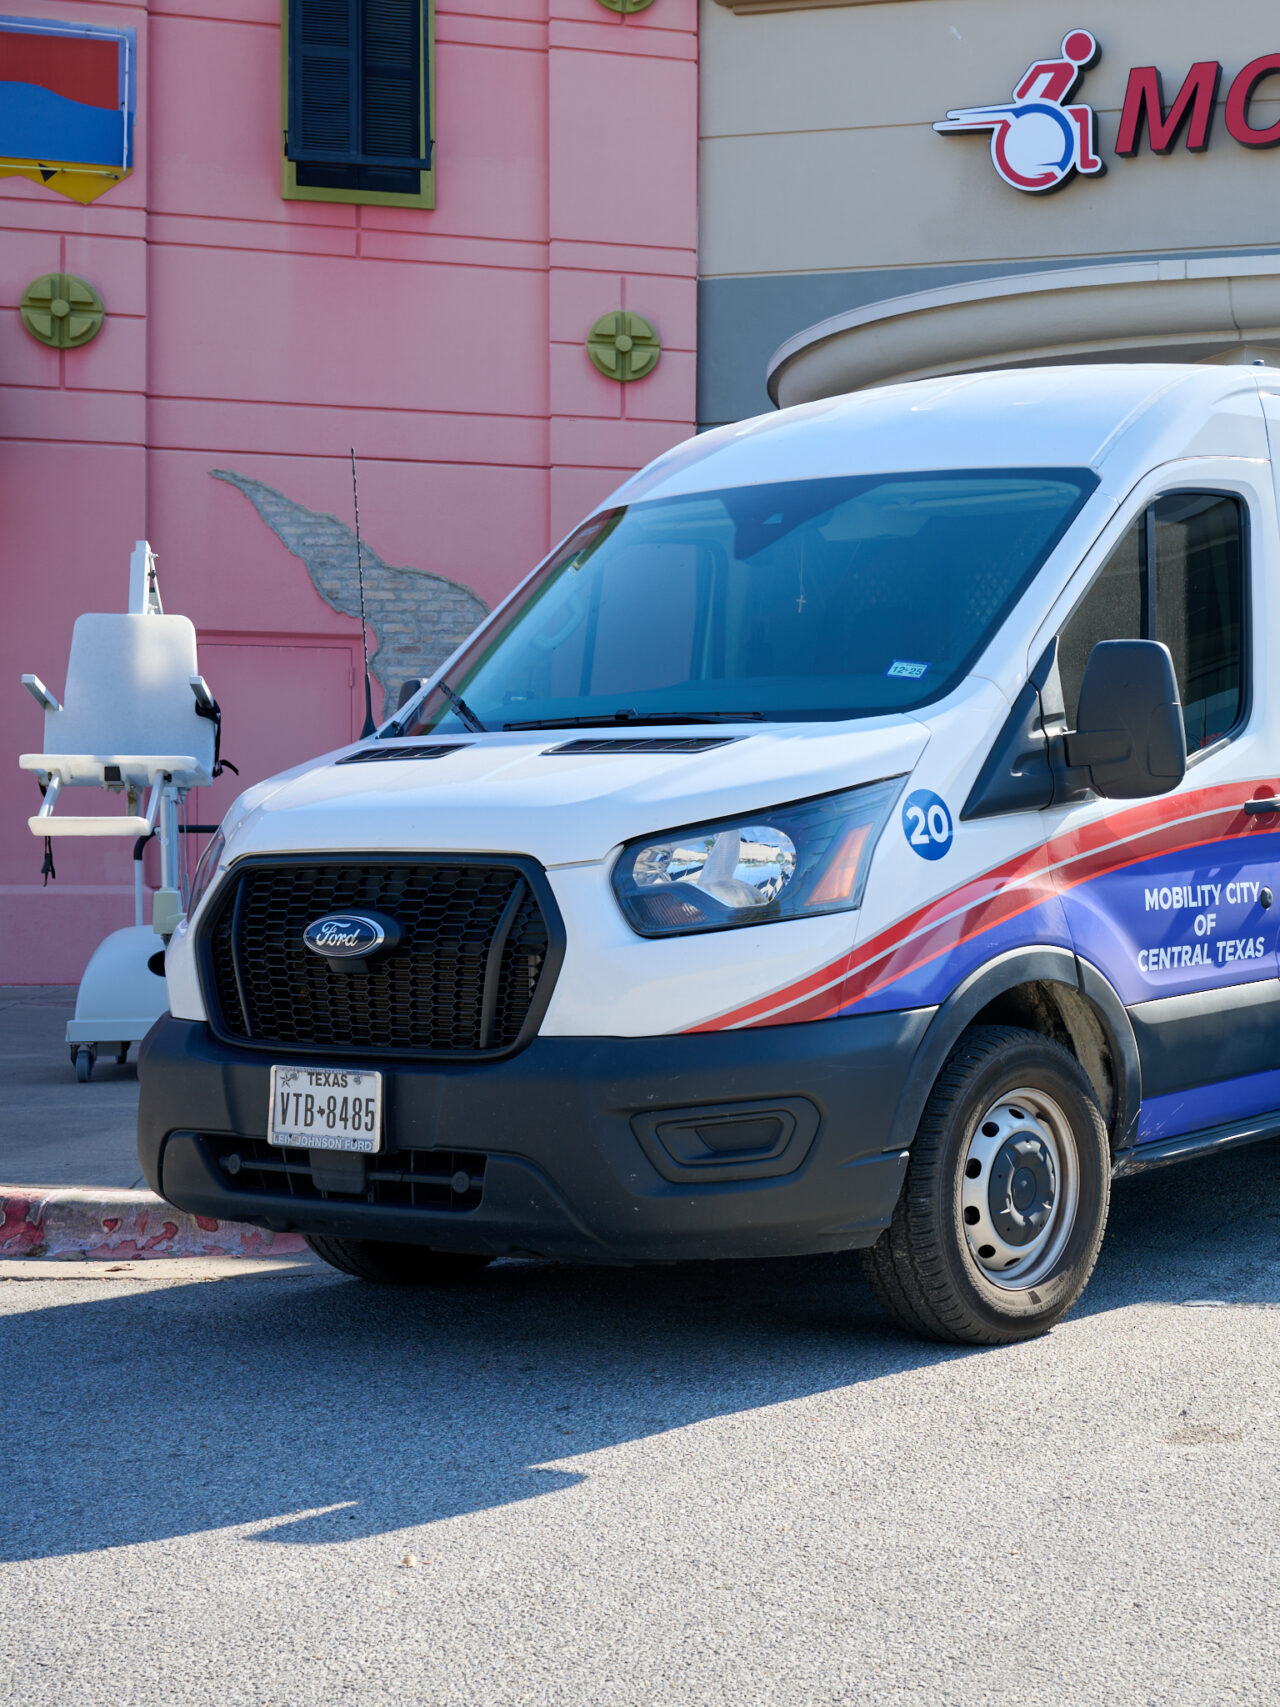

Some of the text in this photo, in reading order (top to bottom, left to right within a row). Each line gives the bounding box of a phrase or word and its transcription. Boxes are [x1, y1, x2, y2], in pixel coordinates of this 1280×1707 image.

[905, 804, 949, 845] 20
[1144, 881, 1260, 911] MOBILITY CITY
[315, 921, 361, 947] Ford
[1193, 913, 1217, 937] OF
[1137, 936, 1265, 972] CENTRAL TEXAS
[307, 1072, 348, 1088] TEXAS
[297, 1136, 341, 1149] JOHNSON
[345, 1139, 372, 1151] FORD
